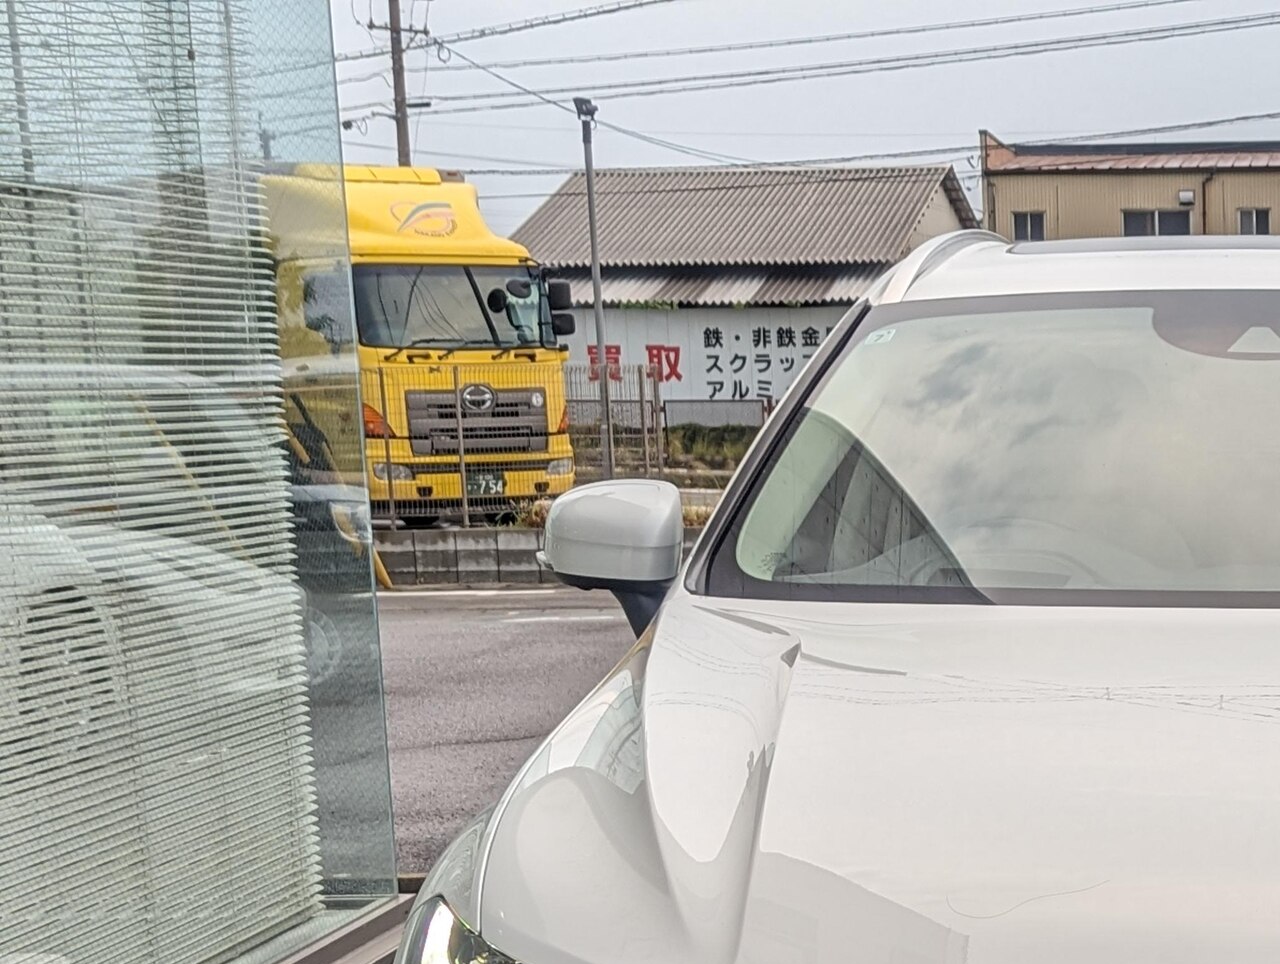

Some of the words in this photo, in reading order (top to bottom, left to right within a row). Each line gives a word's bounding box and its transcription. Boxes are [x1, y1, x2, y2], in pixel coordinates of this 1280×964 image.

[703, 326, 835, 348] 鉄・非鉄金
[587, 344, 683, 382] 買取
[706, 353, 812, 373] スクラッ
[706, 380, 790, 399] アルミ
